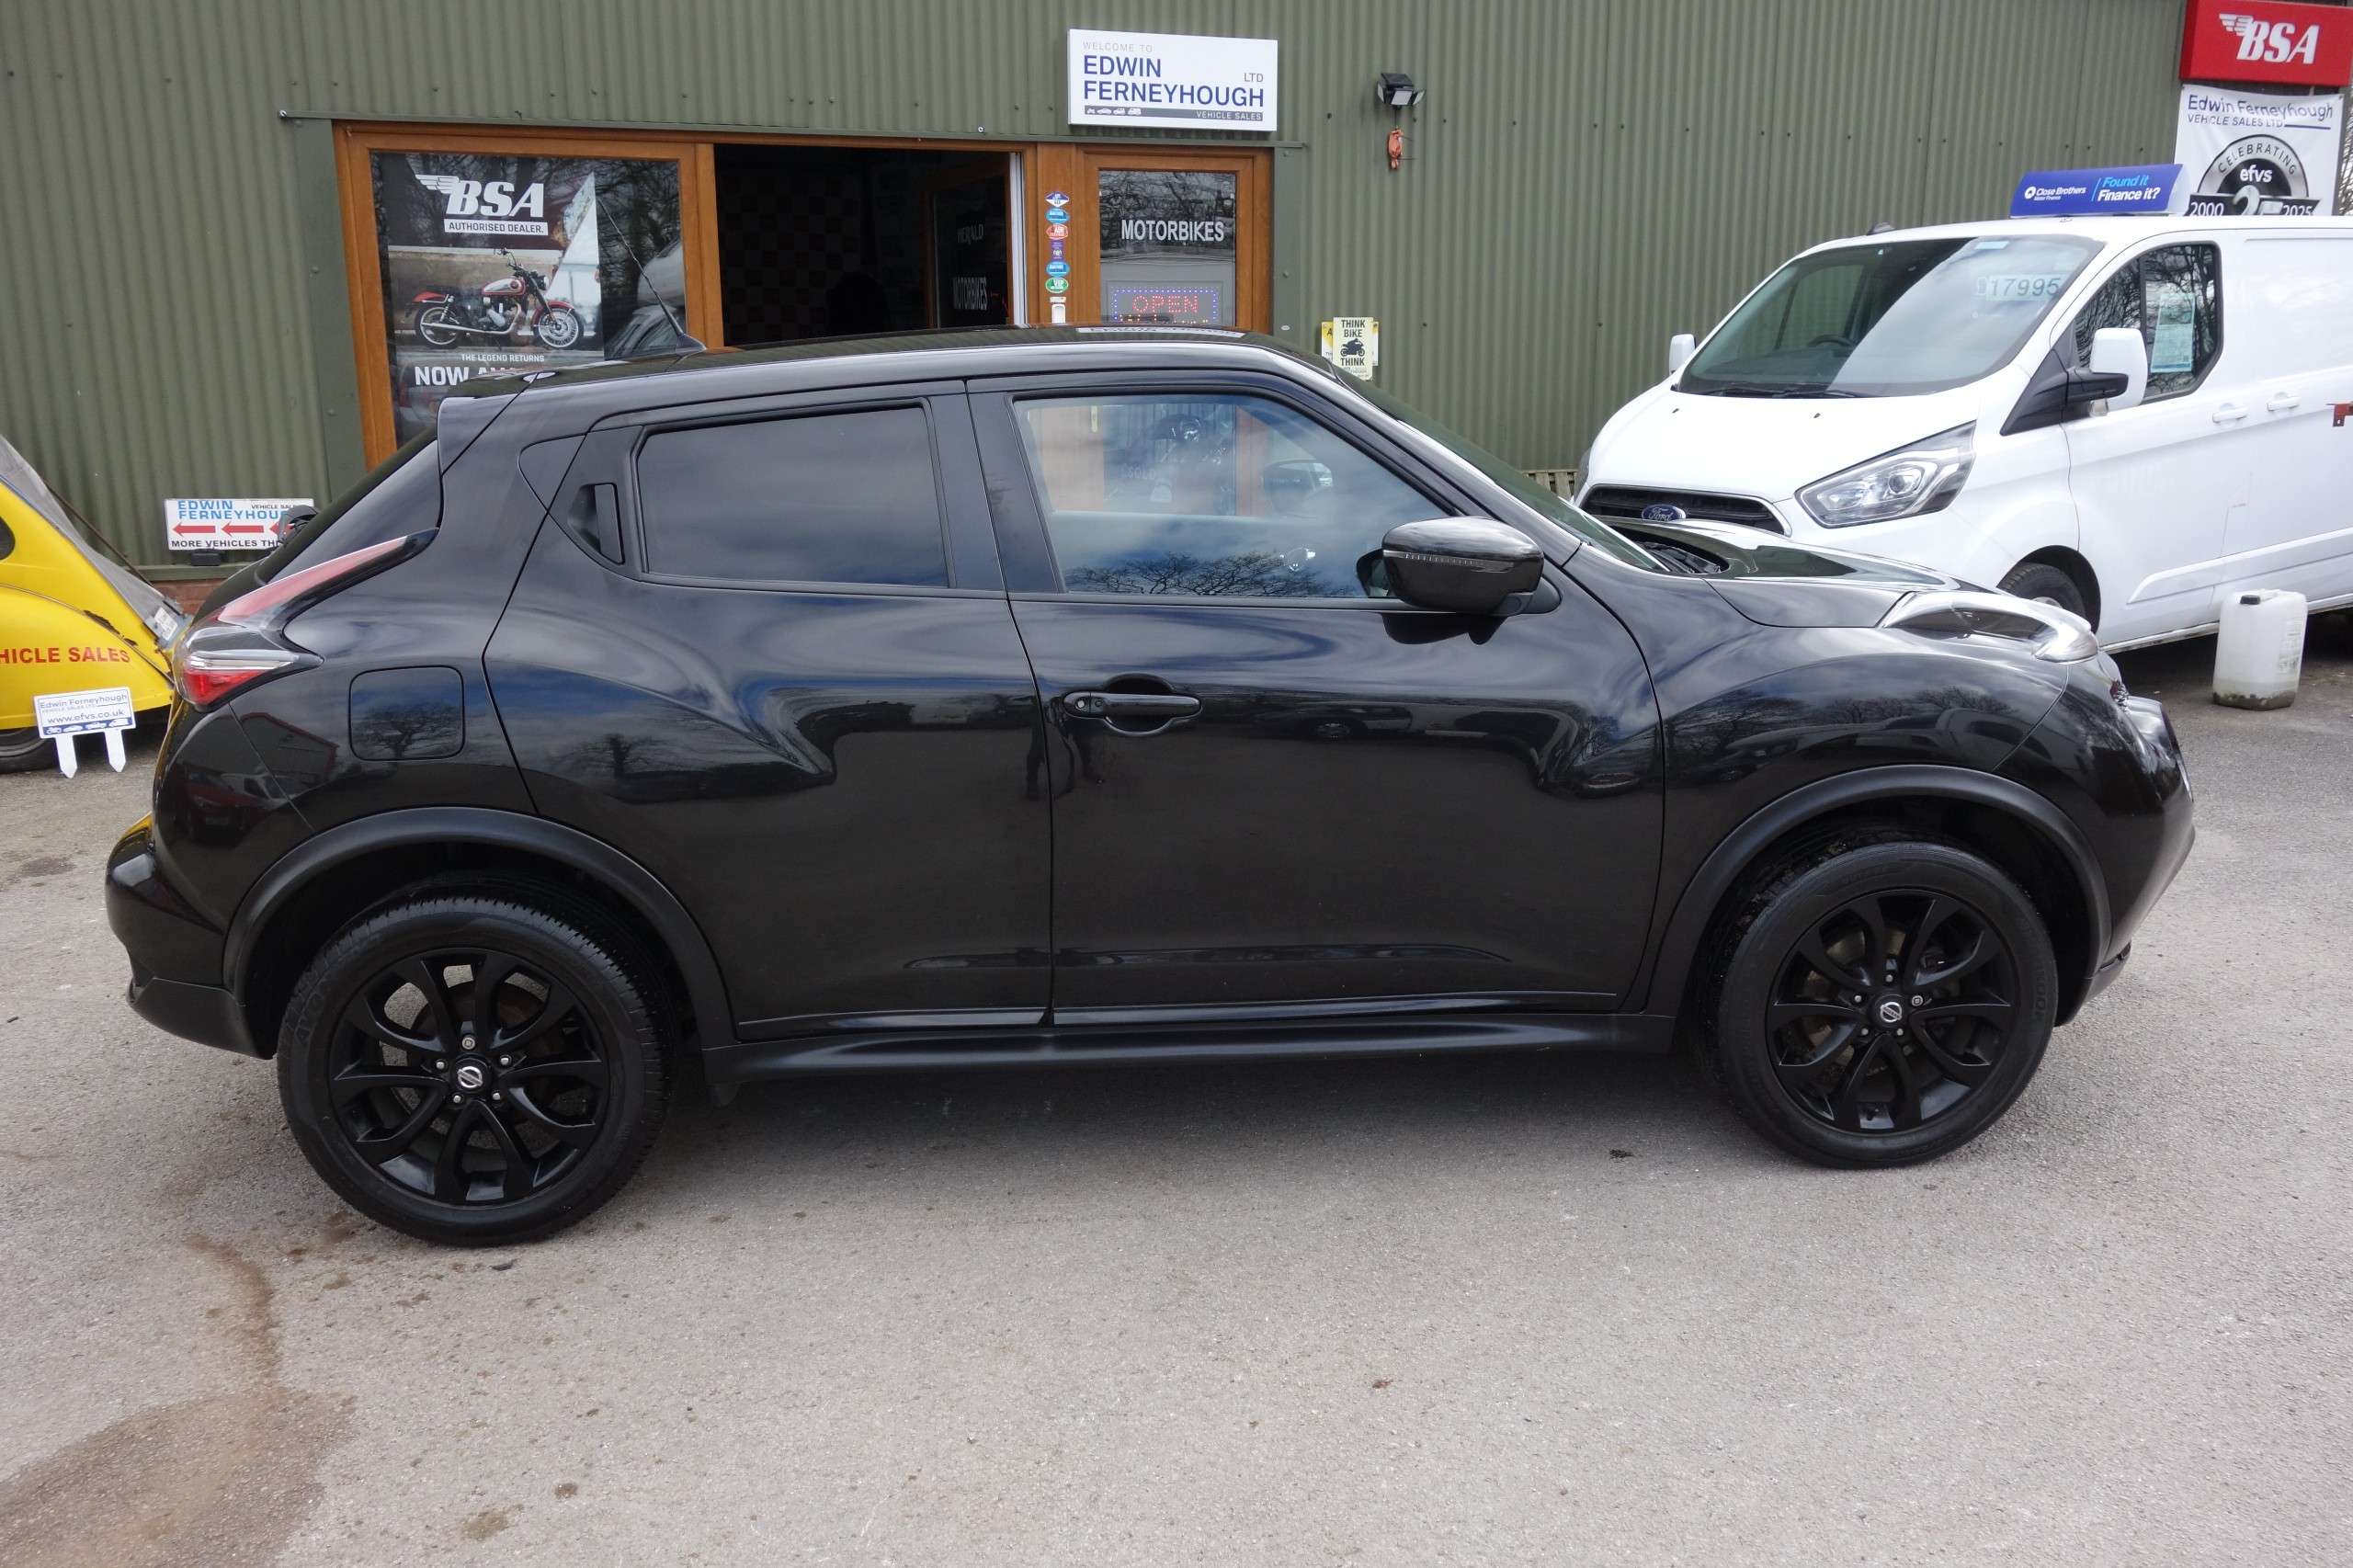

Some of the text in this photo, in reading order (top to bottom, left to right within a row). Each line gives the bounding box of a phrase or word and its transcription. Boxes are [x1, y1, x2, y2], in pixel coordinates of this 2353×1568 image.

[1083, 41, 1154, 53] WELCOME TO
[2236, 20, 2320, 64] BSA
[1084, 55, 1162, 78] EDWIN
[1244, 73, 1264, 83] LTD
[1084, 80, 1264, 107] FERNEYHOUGH
[2188, 95, 2333, 121] Edwin Ferneyhough
[1196, 109, 1262, 120] VEHICLE SALES
[2232, 117, 2263, 127] SALES
[2266, 119, 2283, 128] LTD
[2218, 142, 2297, 175] CELEBRATING
[2240, 165, 2273, 182] efvs
[2102, 175, 2150, 187] Found it
[2036, 187, 2086, 196] Close Brothers
[2097, 187, 2161, 201] Finance it?
[445, 180, 544, 218] BSA
[2189, 201, 2224, 216] 2000
[449, 222, 544, 233] AUTHORISED DEALER.
[1121, 219, 1224, 242] MOTORBIKES
[1132, 295, 1198, 312] OPEN
[1341, 319, 1366, 328] THINK
[1344, 329, 1363, 337] BIKE
[477, 354, 507, 362] LEGEND
[1340, 358, 1365, 366] THINK
[415, 367, 470, 386] NOW
[177, 500, 233, 510] EDWIN
[178, 510, 286, 519] FERNEYHOU
[171, 540, 202, 548] MORE
[205, 540, 257, 548] VEHICLES
[68, 646, 131, 664] SALES
[40, 699, 67, 709] Edwin
[48, 709, 125, 723] www.efvs.co.uk
